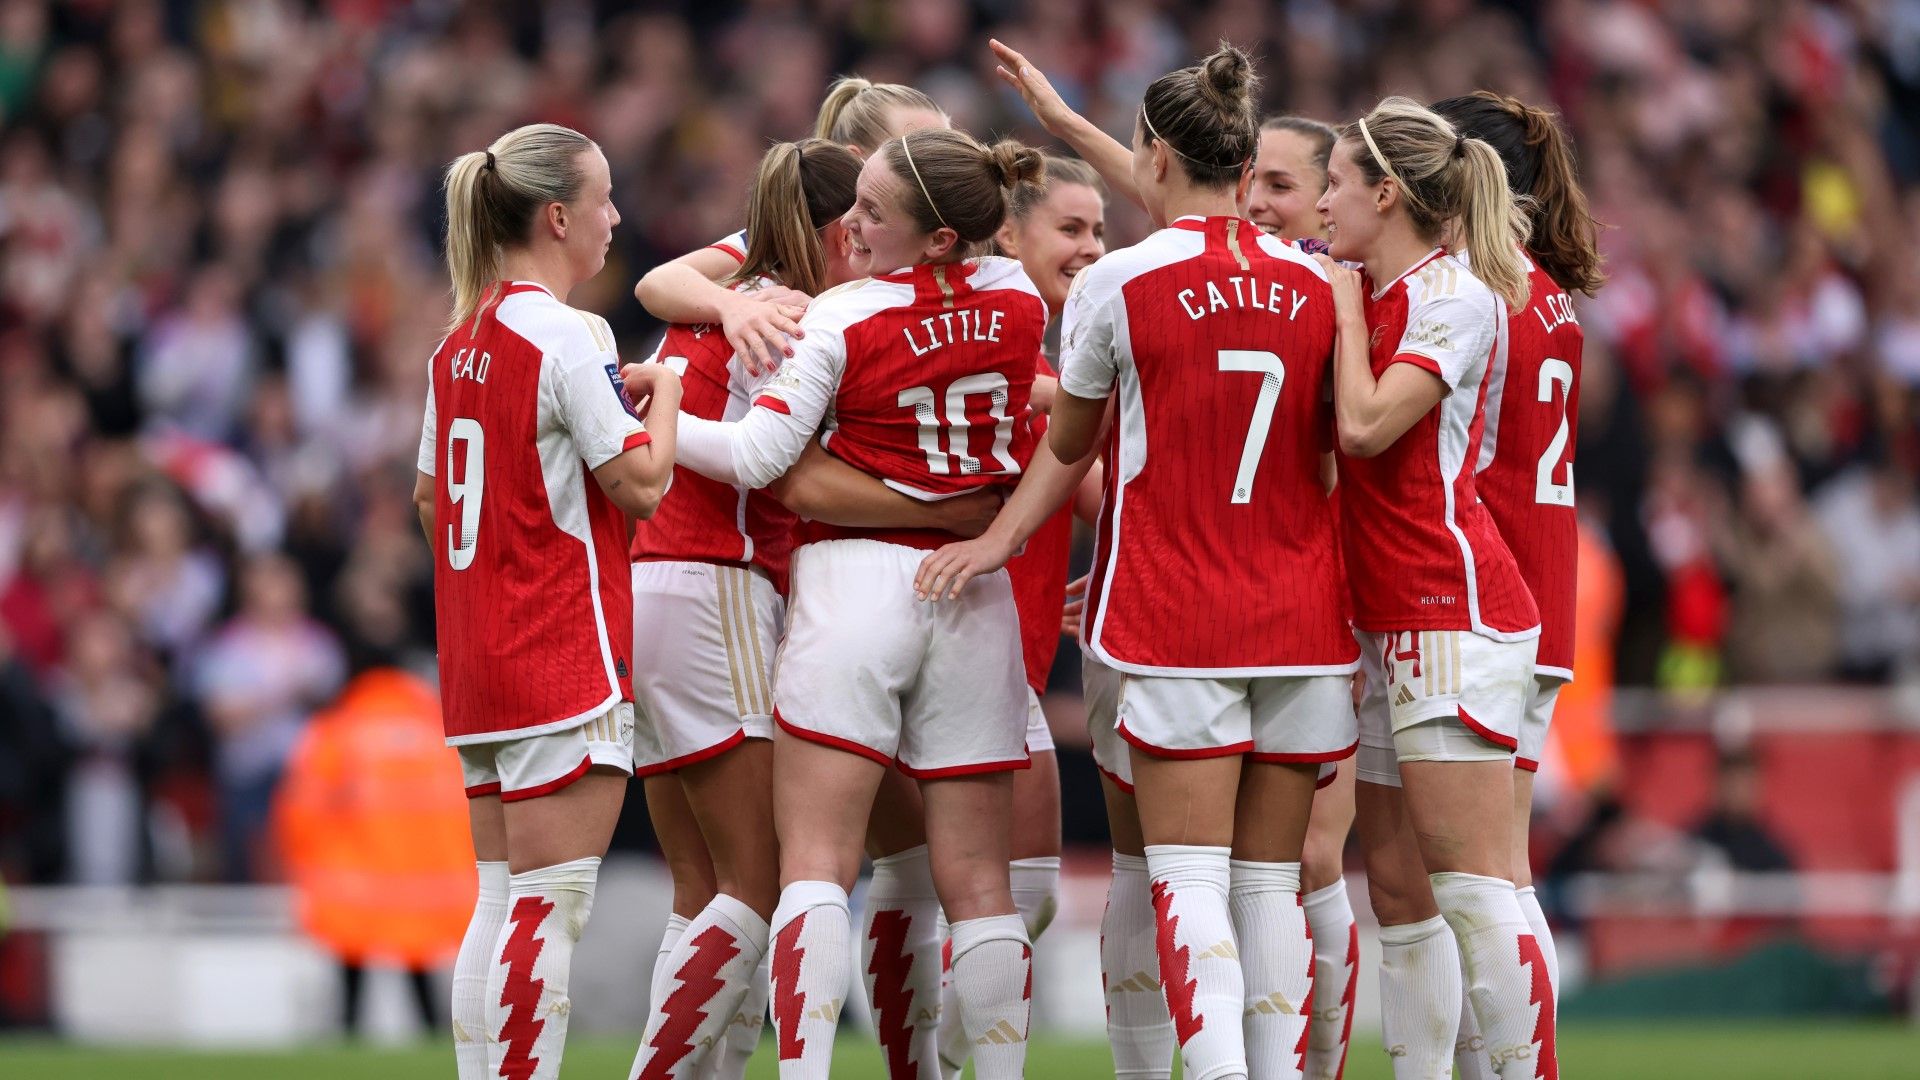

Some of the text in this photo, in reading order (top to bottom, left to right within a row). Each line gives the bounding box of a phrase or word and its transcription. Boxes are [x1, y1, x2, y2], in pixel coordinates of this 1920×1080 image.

[1177, 276, 1308, 321] CATLEY
[1533, 293, 1580, 334] L.CO
[903, 309, 1005, 357] LITTLE
[897, 371, 1022, 475] 10
[1217, 349, 1286, 504] 7
[1535, 357, 1575, 507] 2
[447, 417, 486, 571] 9
[1420, 596, 1456, 605] HEAT.RDY
[1455, 1035, 1485, 1057] FC
